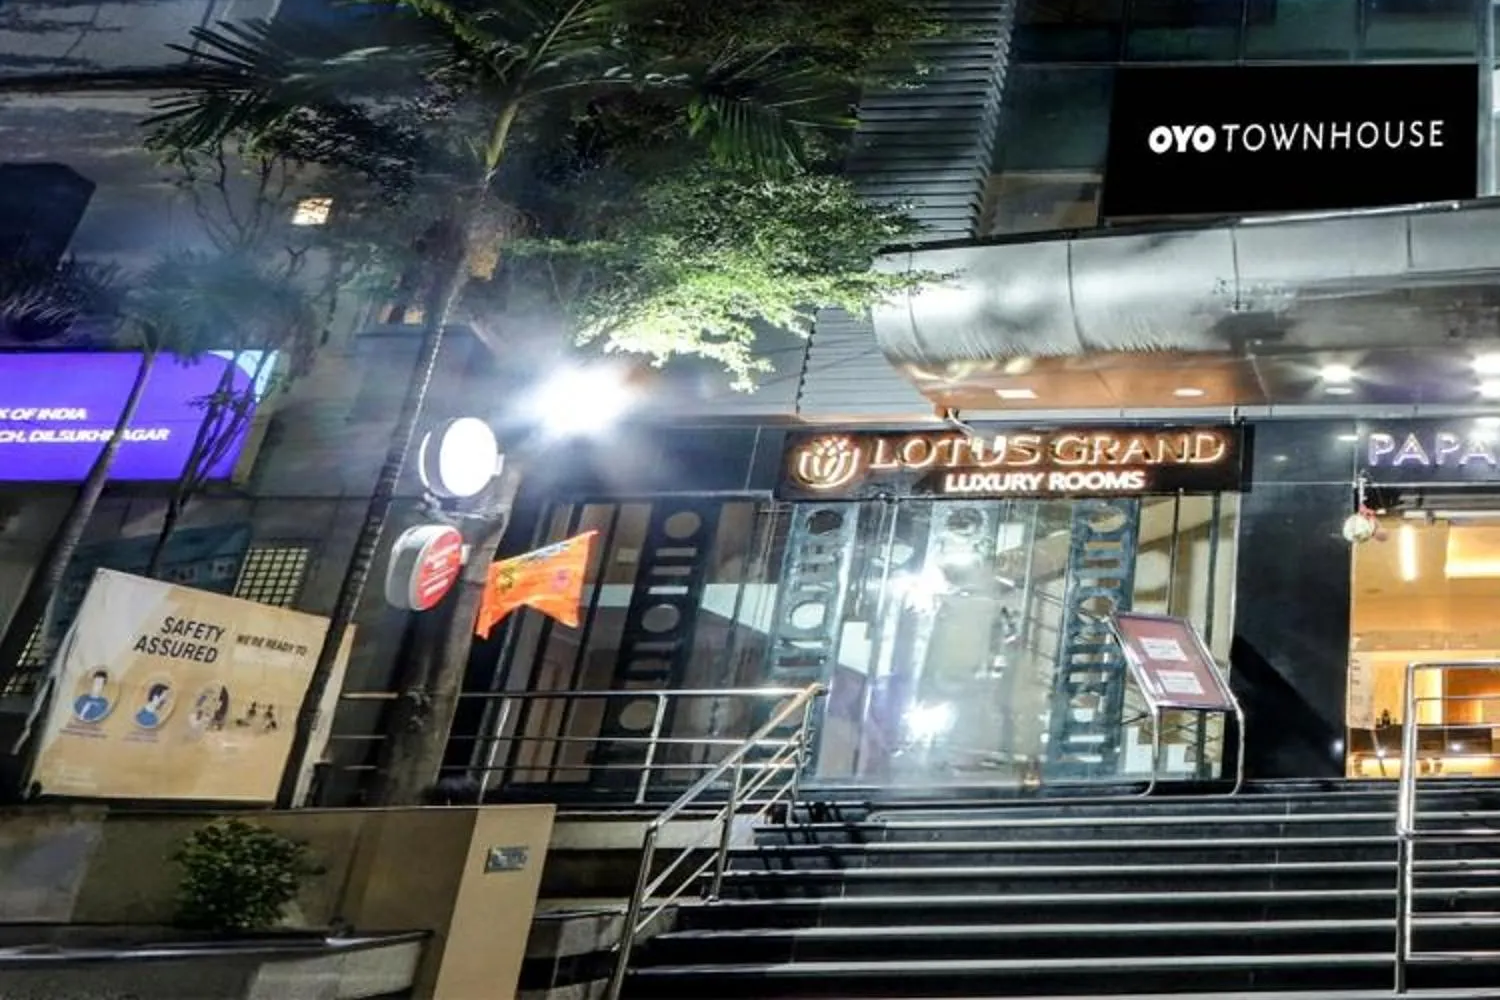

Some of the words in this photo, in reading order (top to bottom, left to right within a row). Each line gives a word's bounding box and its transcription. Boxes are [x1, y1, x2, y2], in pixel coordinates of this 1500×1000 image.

[1148, 125, 1217, 154] OYO
[1221, 120, 1445, 152] TOWNHOUSE
[10, 408, 38, 421] OF
[36, 408, 88, 420] INDIA
[29, 429, 171, 443] DILSUKHAGAR
[869, 433, 1042, 470] LOTUS
[1052, 431, 1228, 468] GRAND
[944, 472, 1046, 493] LUXURY
[1048, 470, 1146, 491] ROOMS
[160, 615, 226, 643] SAFETY
[133, 635, 220, 664] ASSURED
